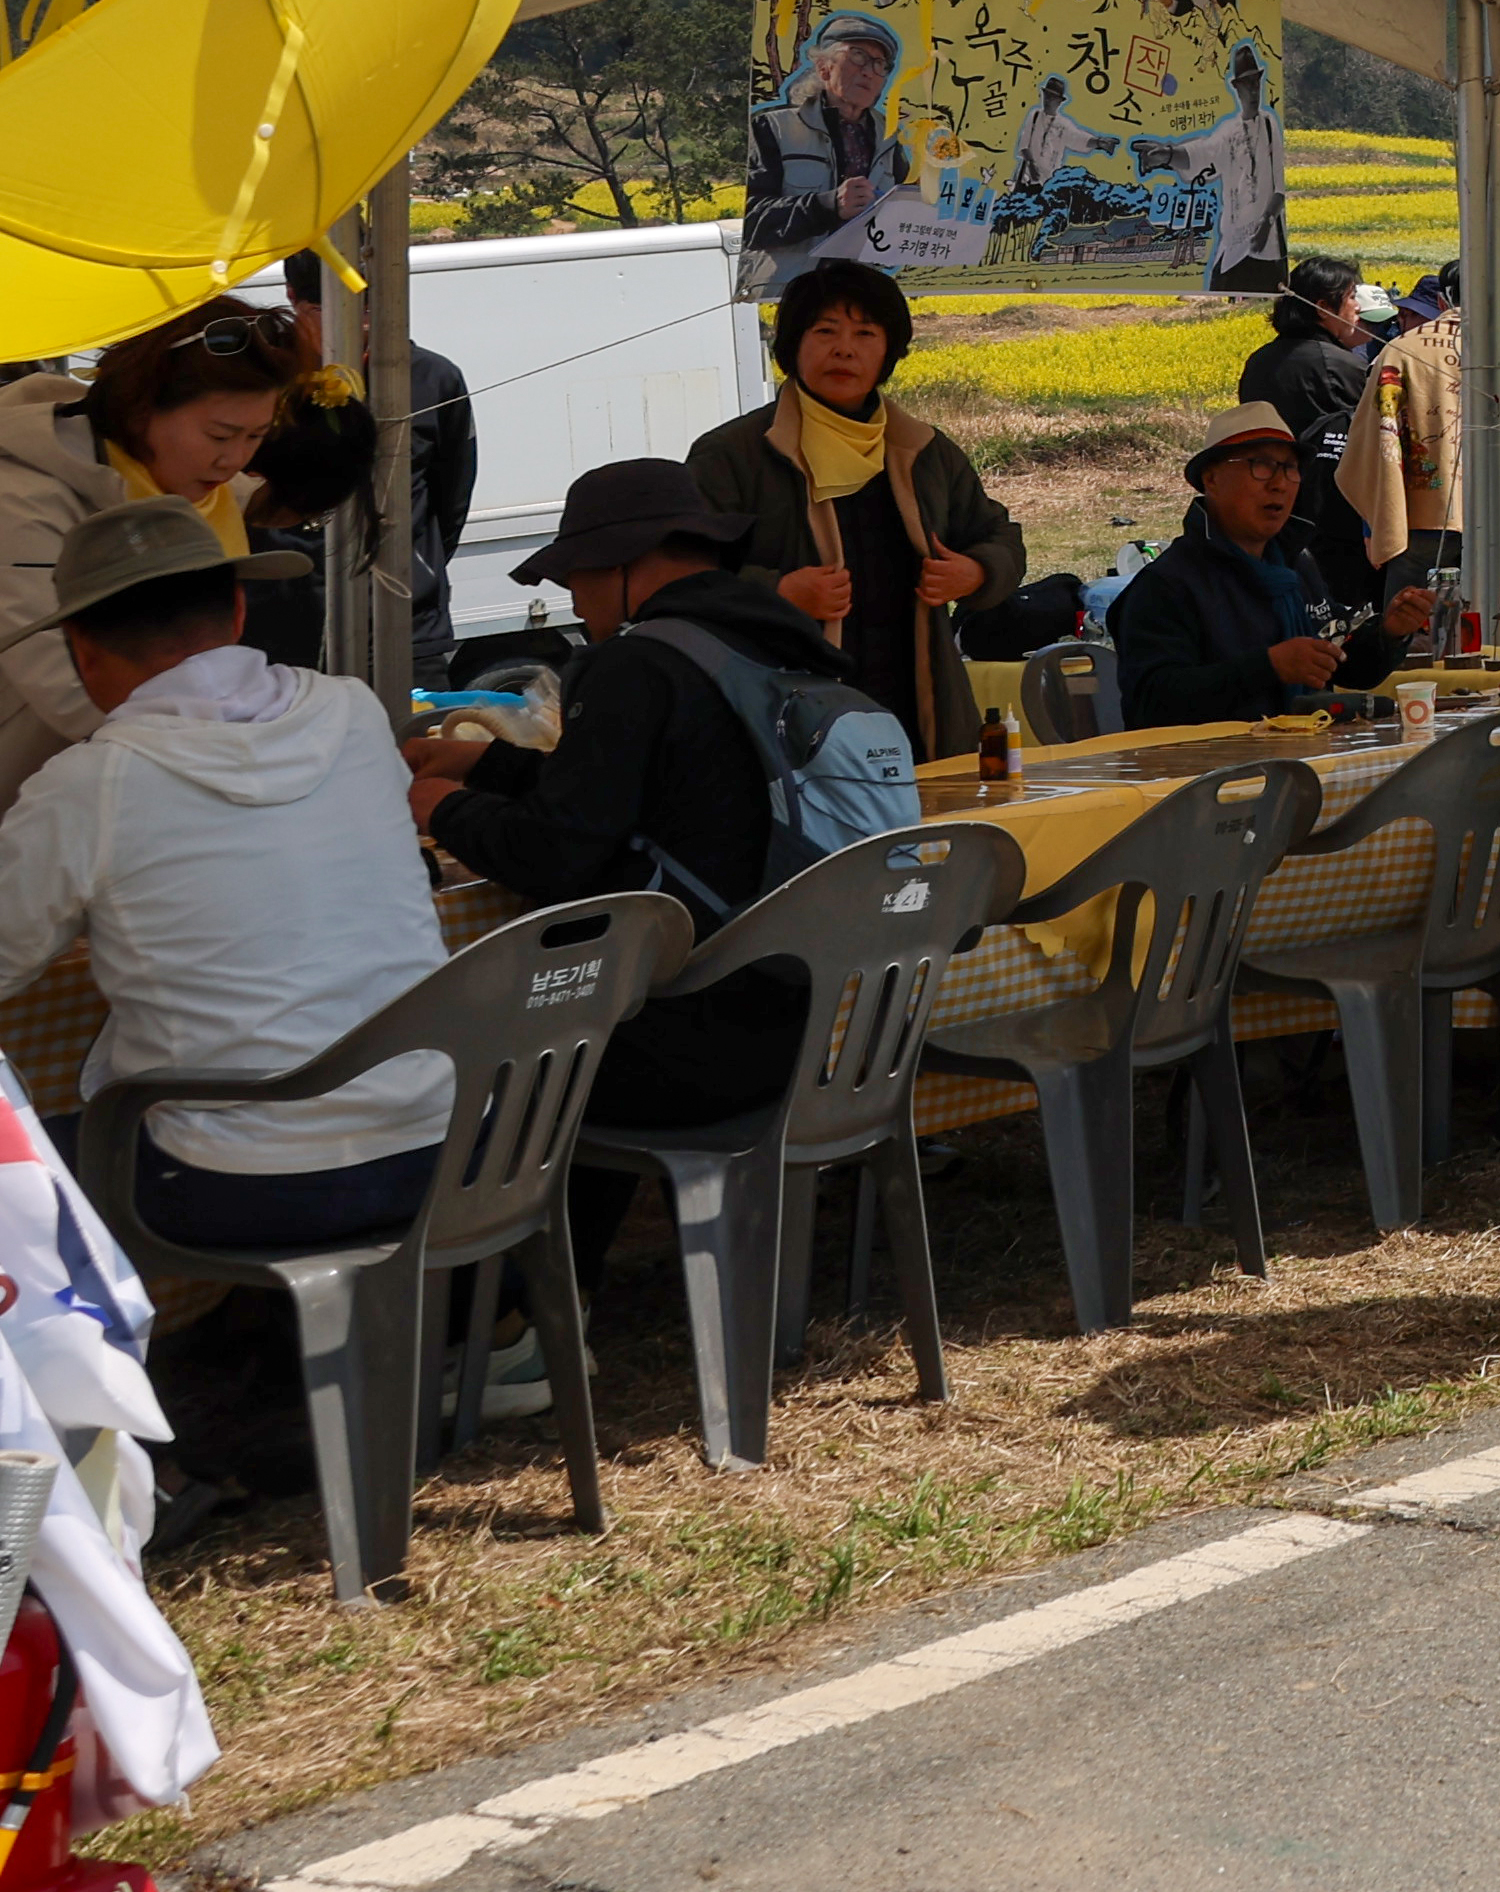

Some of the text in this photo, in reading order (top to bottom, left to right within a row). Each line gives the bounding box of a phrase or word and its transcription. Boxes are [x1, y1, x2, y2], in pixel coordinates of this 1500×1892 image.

[1197, 109, 1216, 128] 작가
[881, 765, 900, 779] K2
[531, 958, 603, 993] 남도기획
